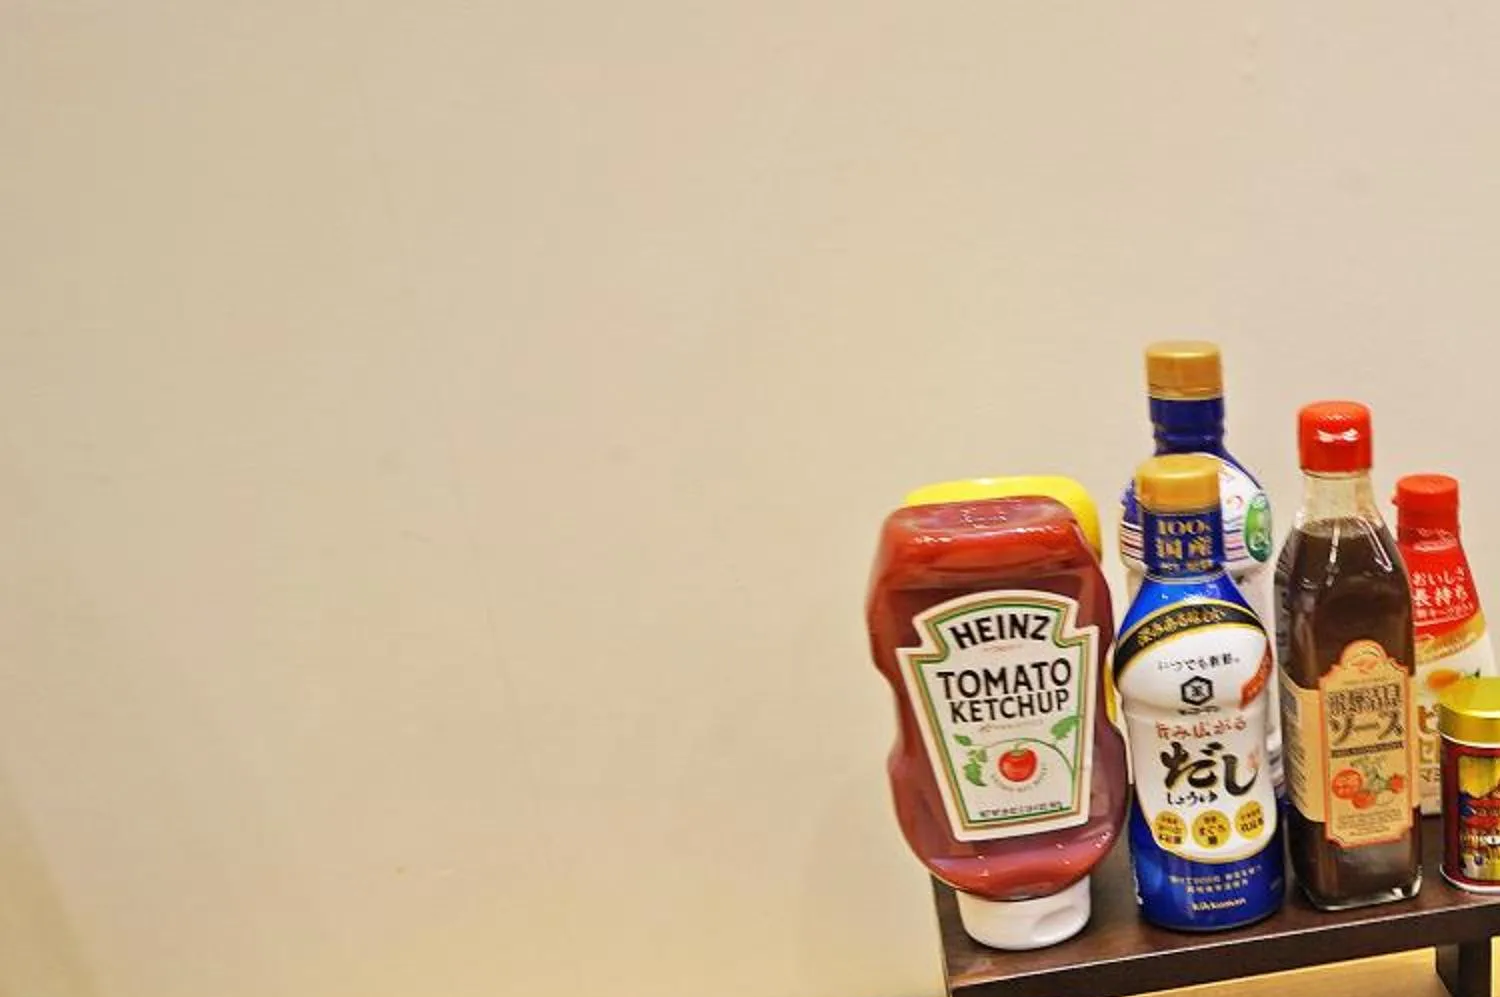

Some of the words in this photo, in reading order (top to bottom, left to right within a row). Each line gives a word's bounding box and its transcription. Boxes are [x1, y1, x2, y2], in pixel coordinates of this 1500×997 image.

[948, 613, 1051, 650] HEINZ
[935, 658, 1073, 699] TOMATO
[948, 689, 1070, 724] KETCHUP
[1327, 711, 1405, 746] ソース
[1159, 741, 1260, 797] だし
